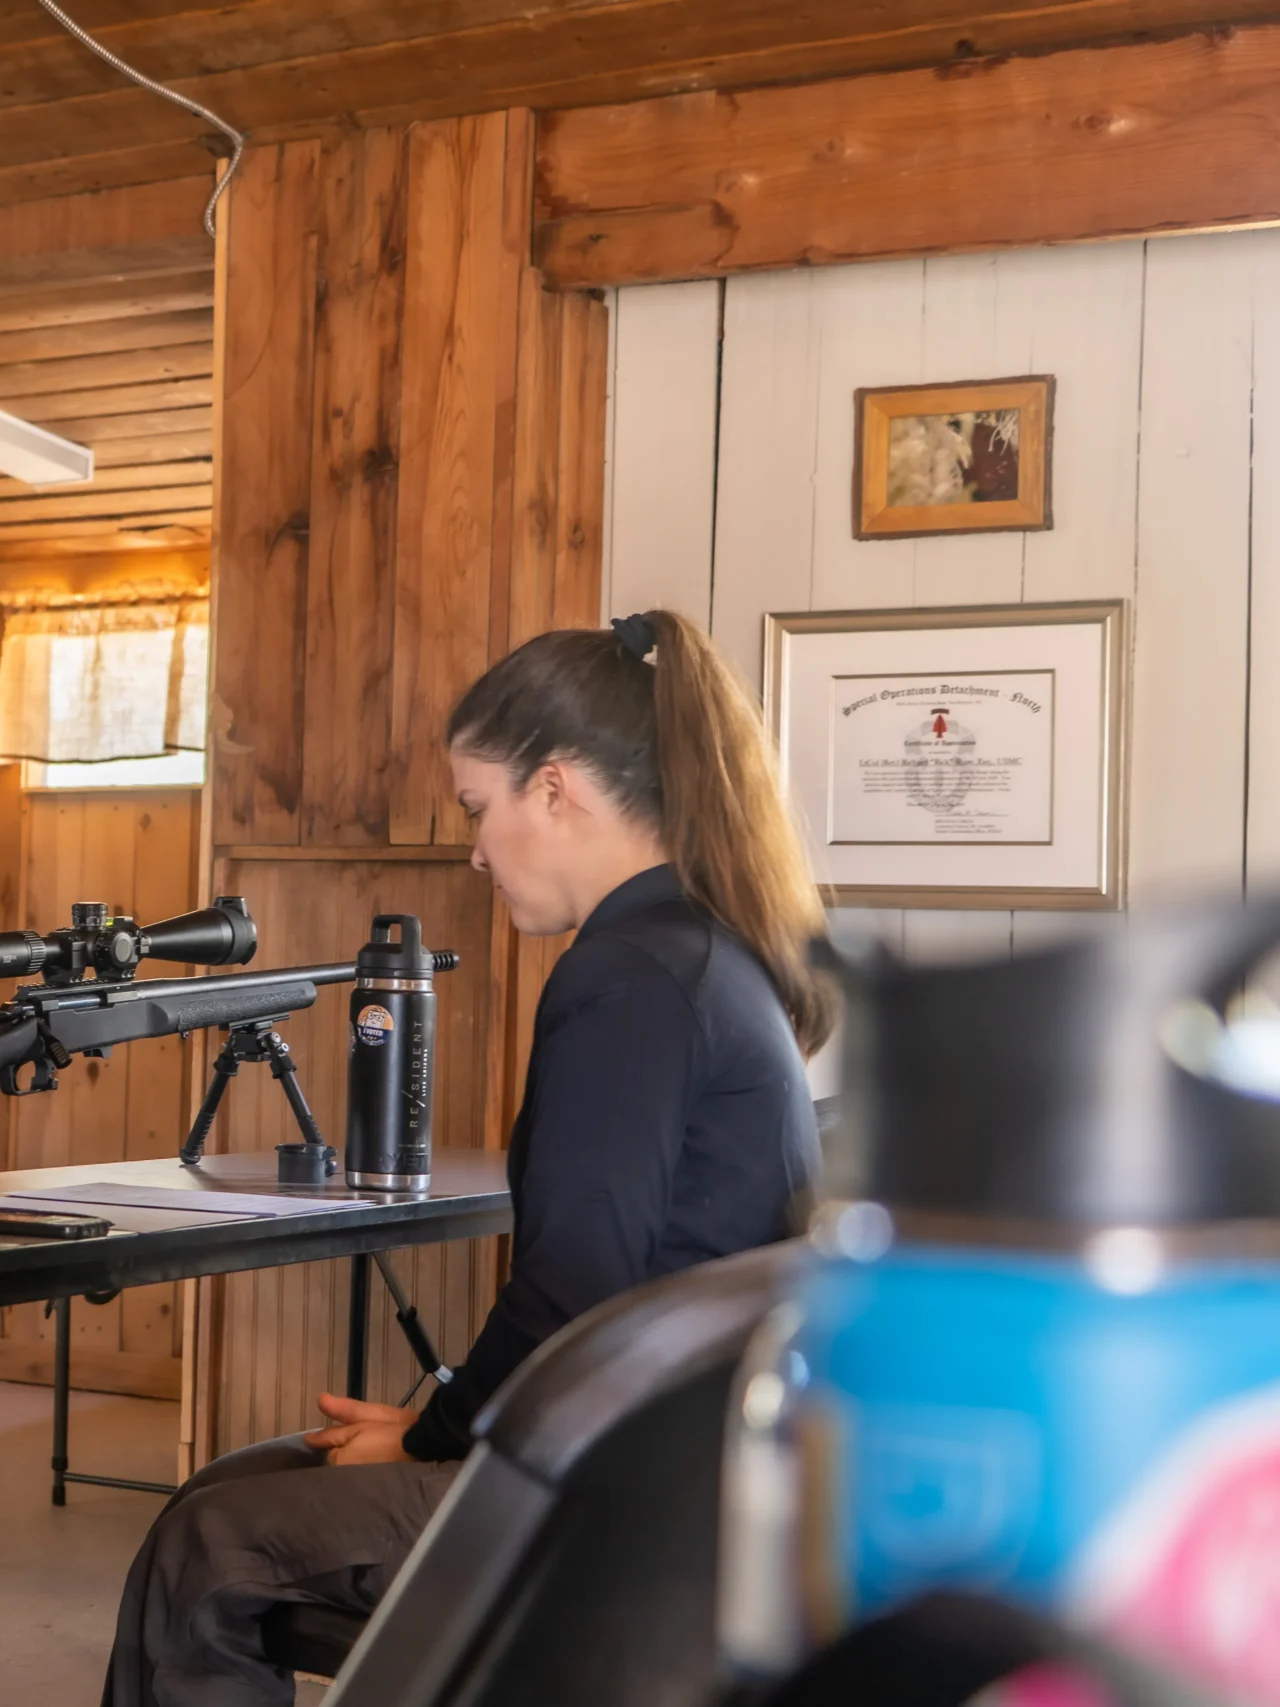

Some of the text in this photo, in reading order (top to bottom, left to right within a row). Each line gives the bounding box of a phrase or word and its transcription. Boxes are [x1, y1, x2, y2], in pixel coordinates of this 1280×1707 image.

[841, 693, 878, 717] Special
[880, 687, 937, 700] Operations
[940, 685, 999, 697] Detachment
[1009, 692, 1042, 713] North
